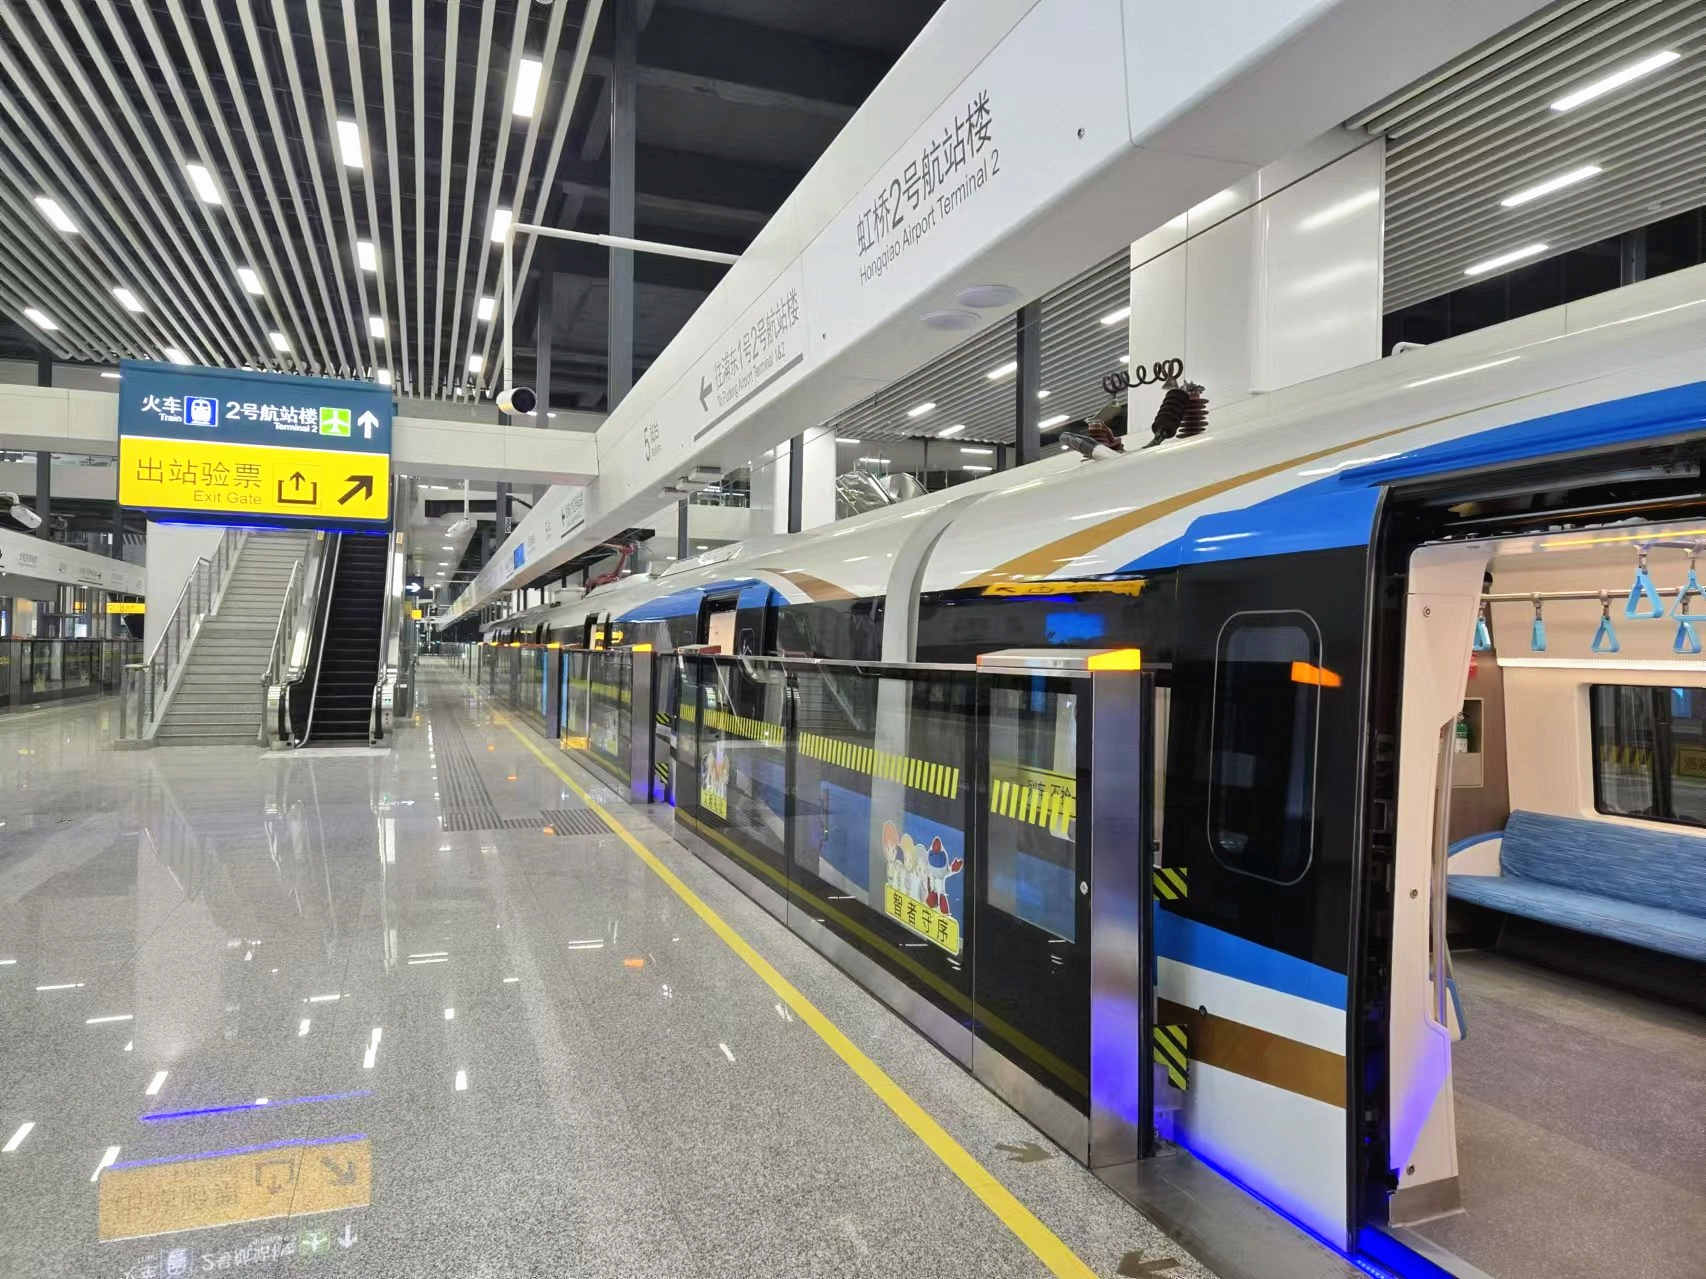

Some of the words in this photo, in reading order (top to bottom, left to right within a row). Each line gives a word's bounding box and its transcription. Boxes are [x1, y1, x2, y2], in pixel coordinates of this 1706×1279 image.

[857, 90, 992, 256] 虹桥2号航站楼
[860, 240, 901, 286] Hongqiao
[902, 207, 936, 250] Airport
[937, 158, 988, 219] Terminal
[991, 148, 1000, 176] 2
[141, 395, 183, 413] 火车
[225, 401, 318, 425] 2号航站楼
[159, 412, 183, 423] Train
[274, 422, 310, 433] Terminal
[311, 425, 318, 433] 2
[136, 457, 262, 489] 出站验票
[193, 490, 222, 503] Exit
[226, 491, 262, 505] Gate
[893, 891, 949, 943] 智者守序
